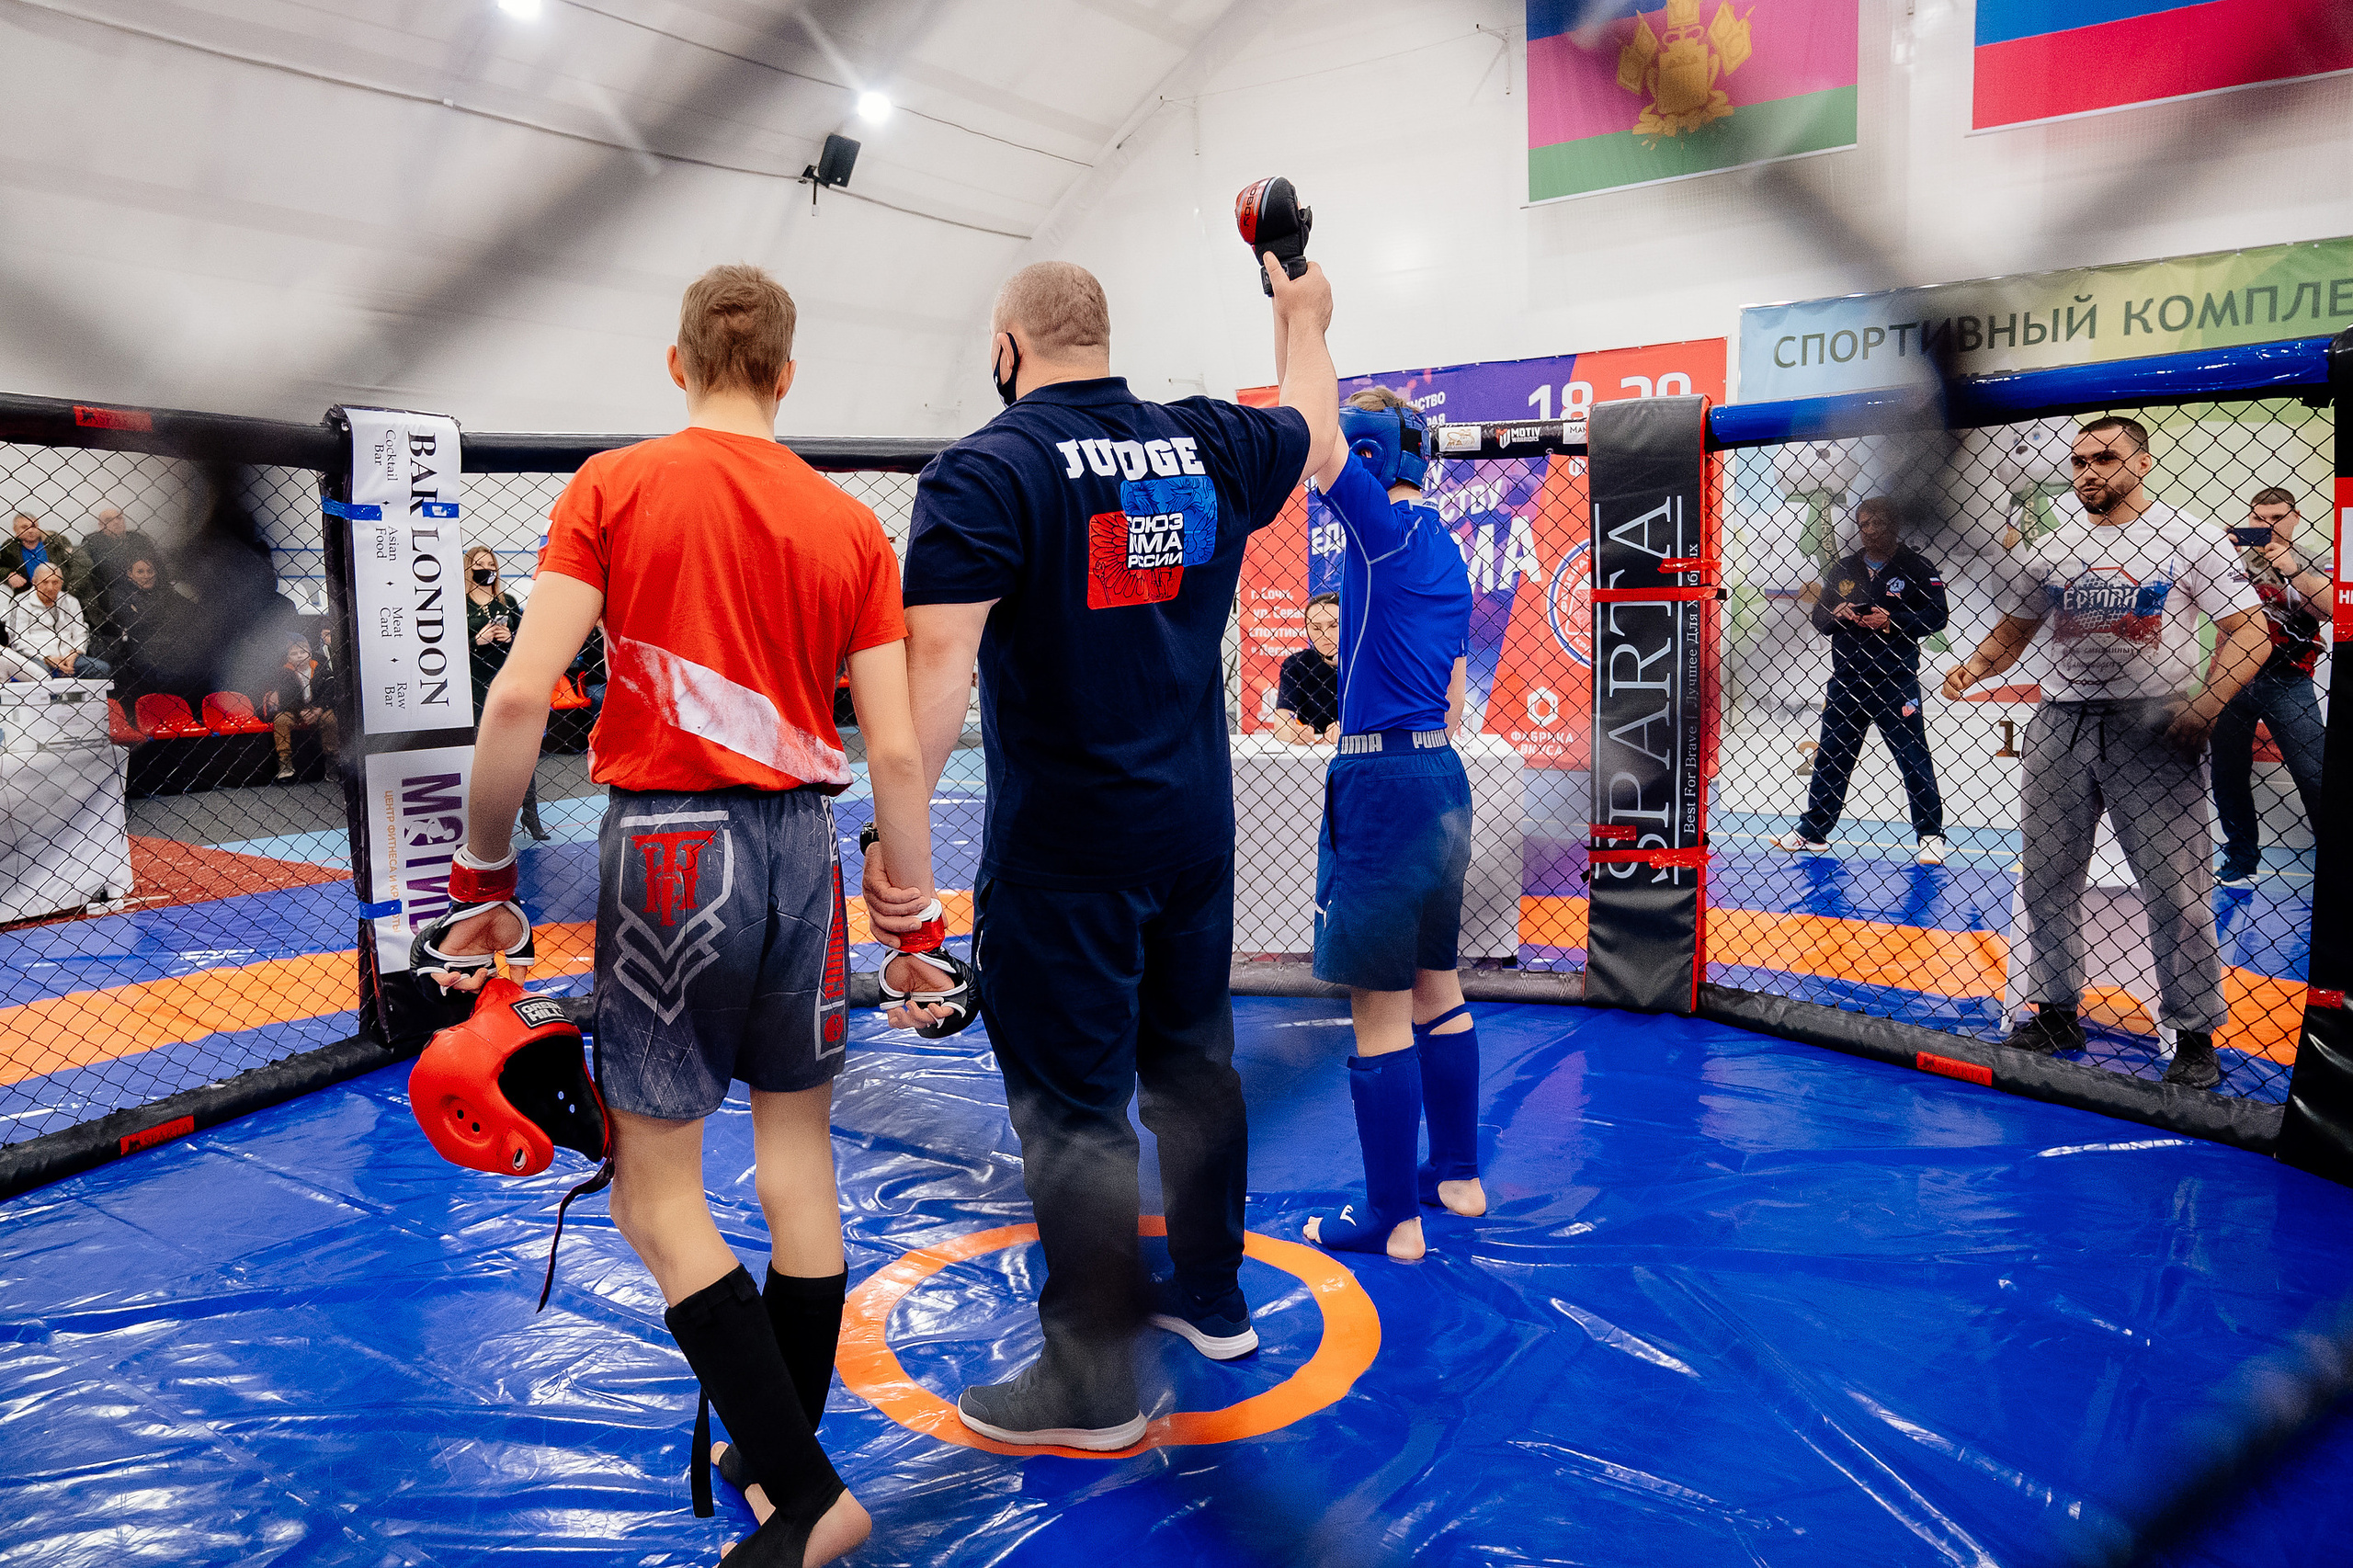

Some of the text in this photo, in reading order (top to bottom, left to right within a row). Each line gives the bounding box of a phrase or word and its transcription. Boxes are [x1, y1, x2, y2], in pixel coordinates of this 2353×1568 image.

[1773, 278, 2353, 369] СПОРТИВНЫЙ КОМПЛЕ
[1511, 427, 1540, 437] MOTIV
[374, 443, 384, 466] Bar
[385, 428, 398, 481] Cocktail
[1056, 437, 1206, 481] JUDGE
[375, 527, 384, 559] Food
[388, 526, 397, 562] Asian
[407, 430, 450, 707] BAR LONDON
[380, 607, 392, 638] Card
[392, 607, 403, 639] Meat
[1687, 613, 1699, 643] Для
[1688, 648, 1699, 708] Лучшее
[384, 686, 393, 707] Bar
[397, 682, 407, 709] Raw
[1340, 733, 1382, 754] UMA
[1510, 731, 1574, 744] ФАБРИКА
[1519, 743, 1563, 756] ВКУСА
[1995, 721, 2020, 757] 1
[1797, 741, 1819, 776] 2
[1684, 725, 1697, 834] Best For Brave
[384, 790, 395, 822] ЦЕНТР
[386, 824, 398, 872] ФИТНЕСА
[390, 885, 402, 933] КРОТЫ
[521, 1001, 562, 1014] GREEN
